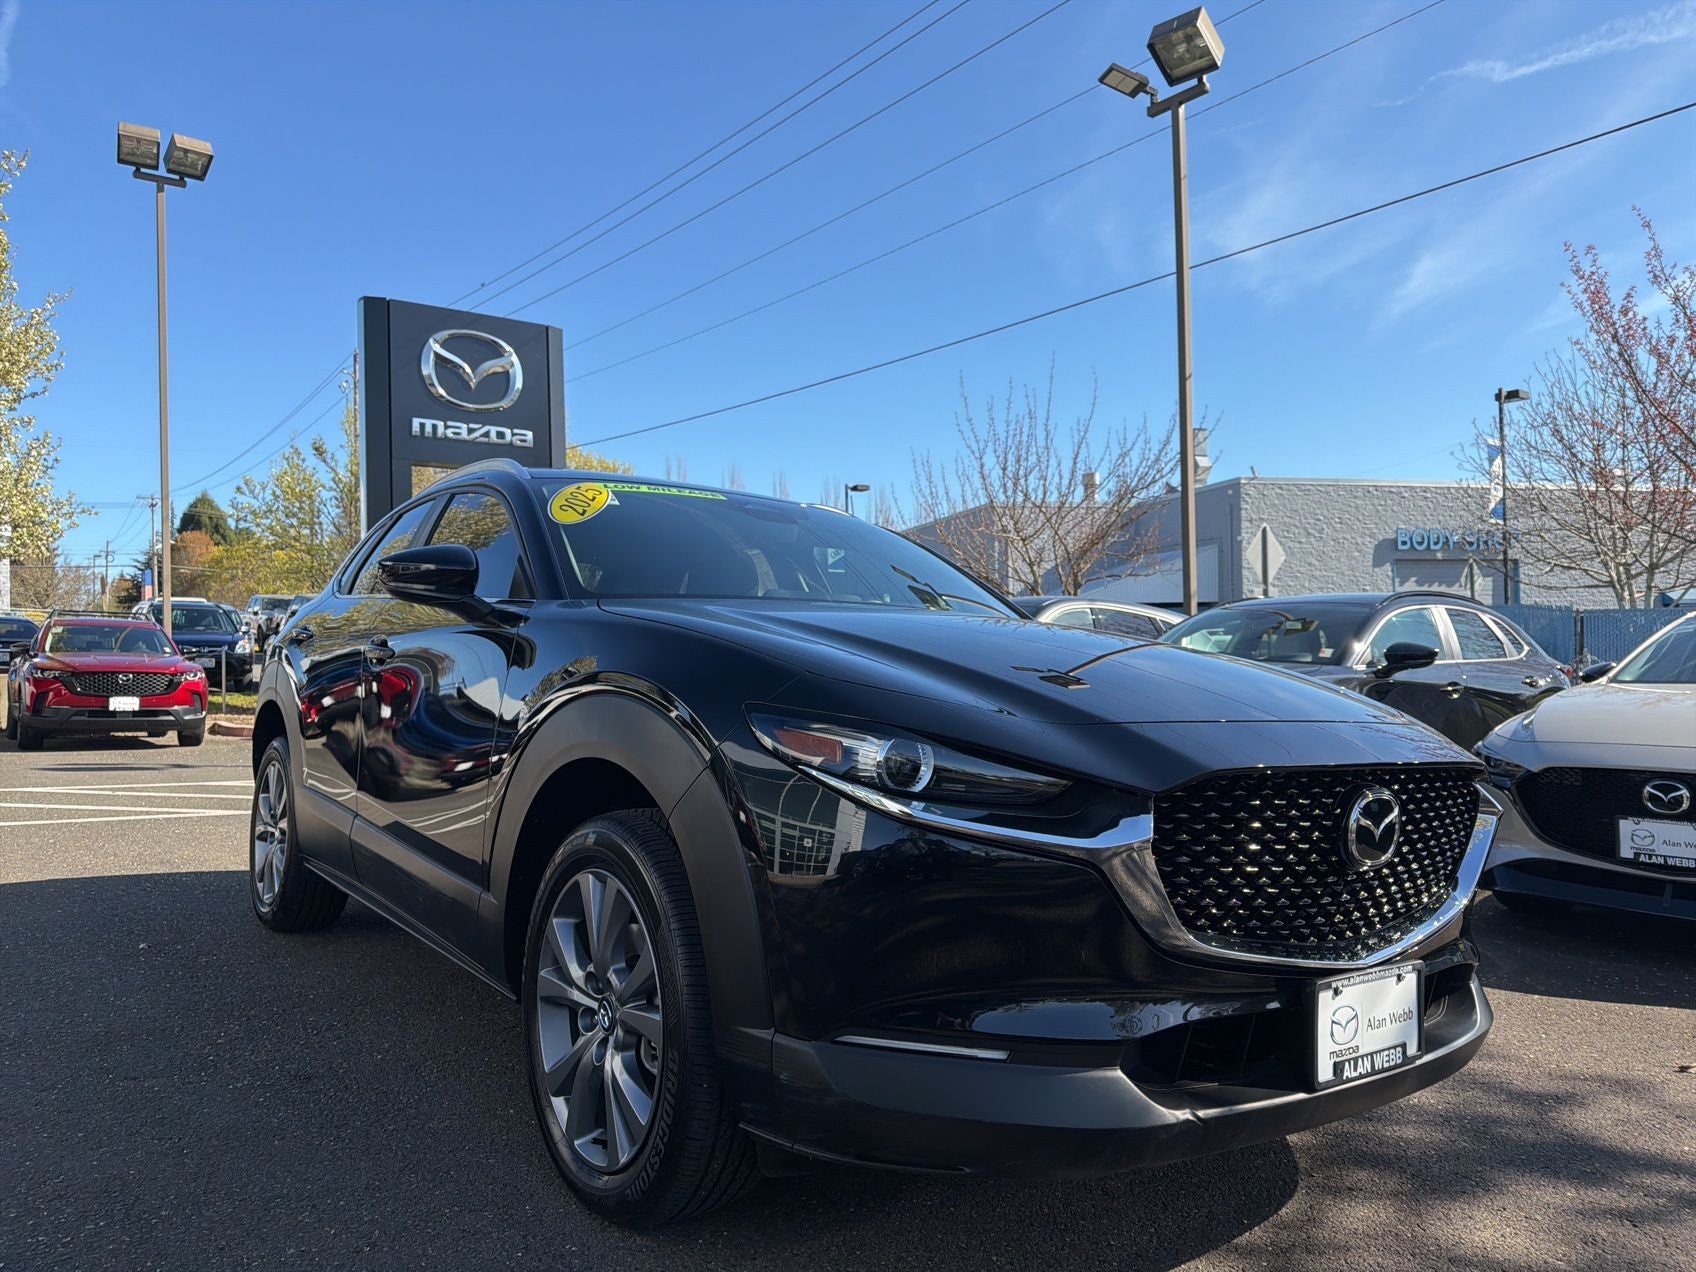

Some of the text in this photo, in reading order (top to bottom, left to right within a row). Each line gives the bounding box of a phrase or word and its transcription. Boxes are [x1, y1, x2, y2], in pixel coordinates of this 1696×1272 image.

[411, 417, 534, 448] mazda
[559, 484, 603, 517] 2025
[603, 483, 722, 499] LOW MILEAGE
[1396, 528, 1457, 551] BODY
[1662, 839, 1681, 848] Alan
[1639, 854, 1695, 868] ALAN WEBB
[1331, 966, 1413, 987] www.alanwebbmazda.com
[1366, 1007, 1413, 1032] Alan Webb
[1329, 1045, 1359, 1060] mazda
[1343, 1047, 1402, 1079] ALAN WEBB
